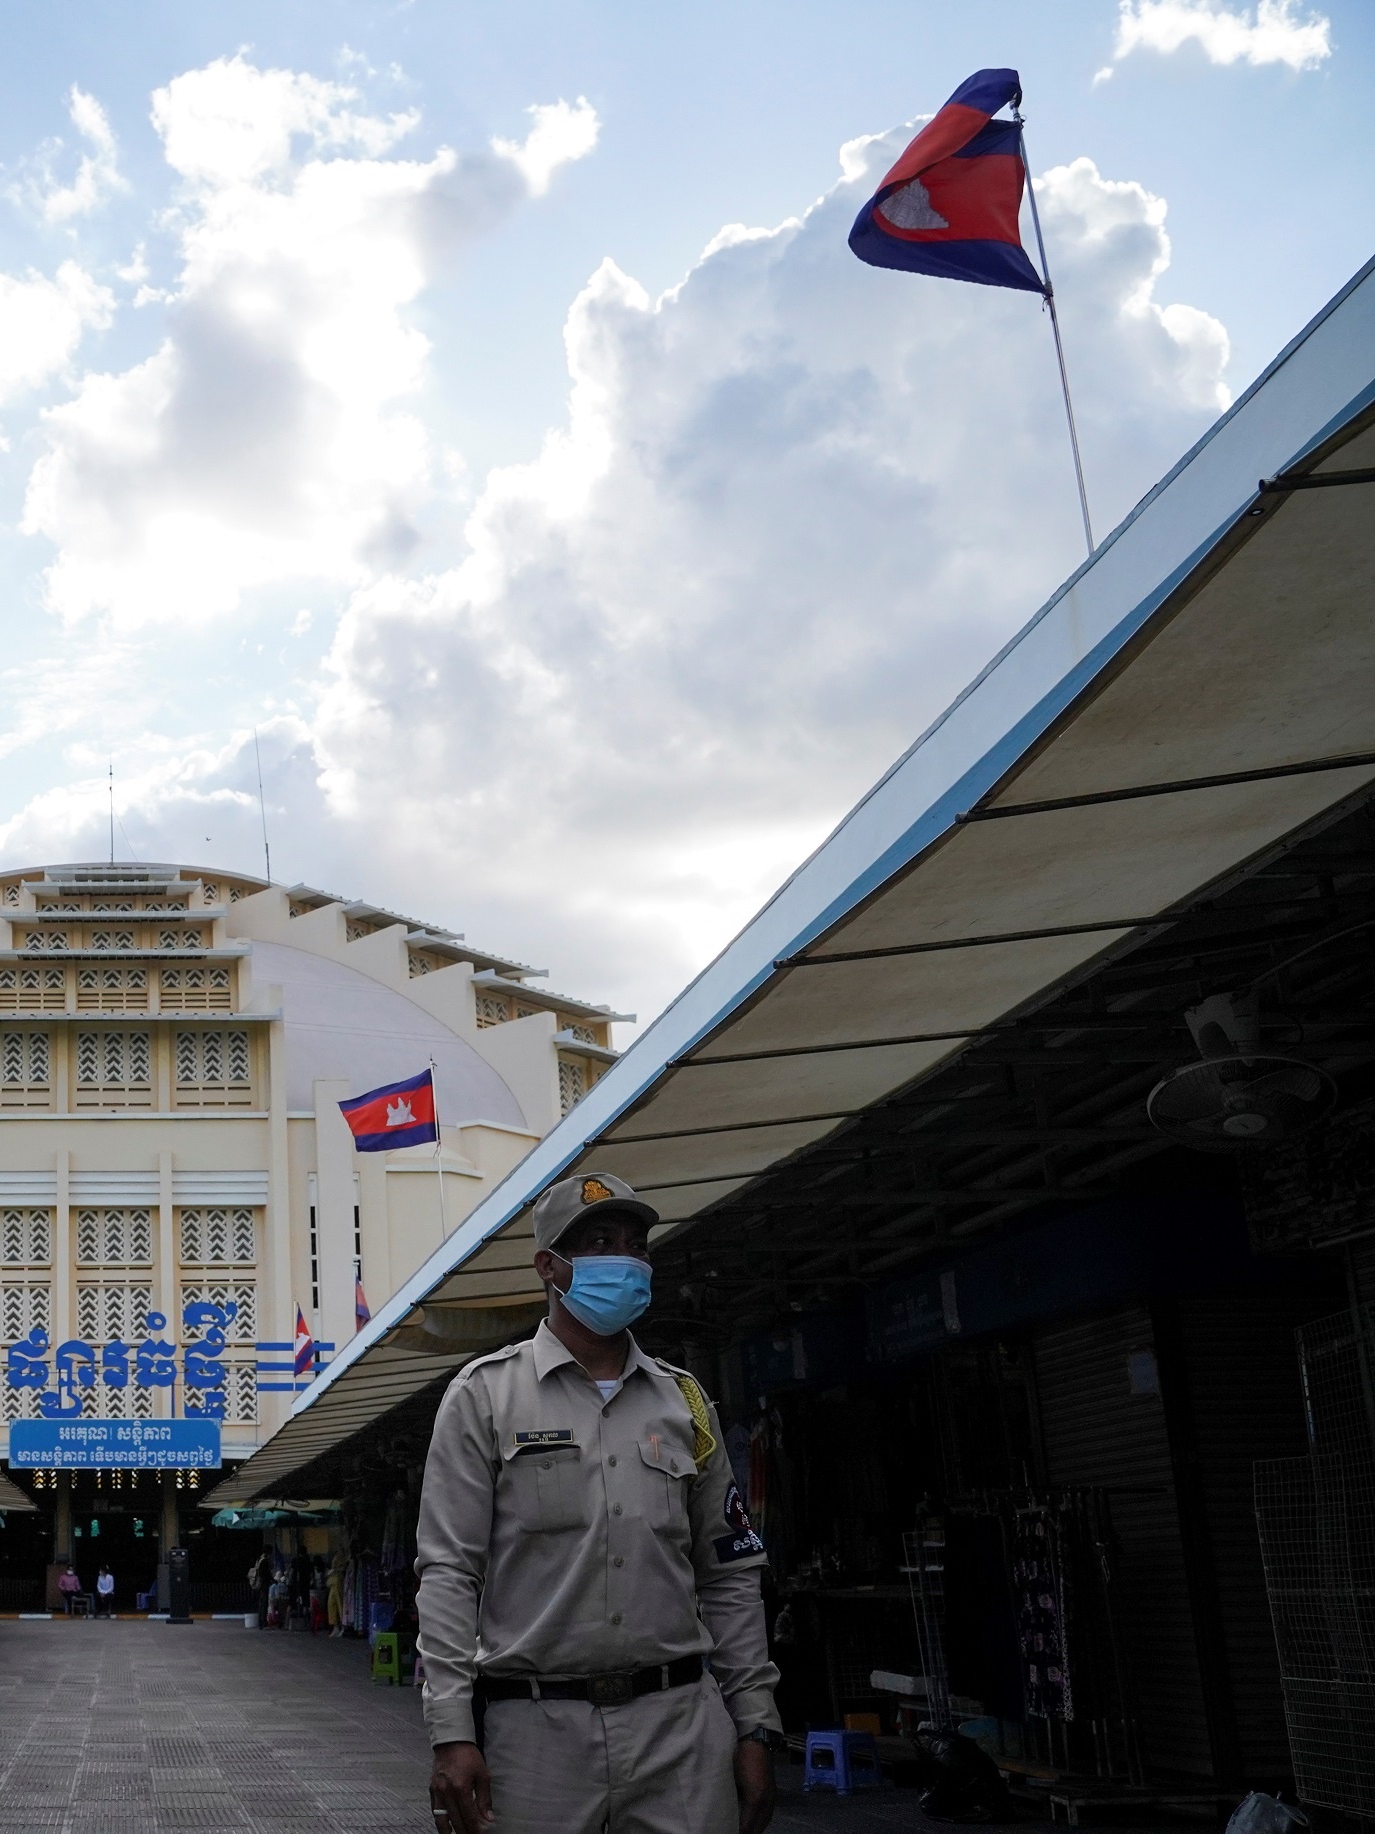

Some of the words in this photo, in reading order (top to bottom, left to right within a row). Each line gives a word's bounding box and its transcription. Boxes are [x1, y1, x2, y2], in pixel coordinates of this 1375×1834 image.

[7, 1302, 237, 1418] ផ្សារធំថ្មី
